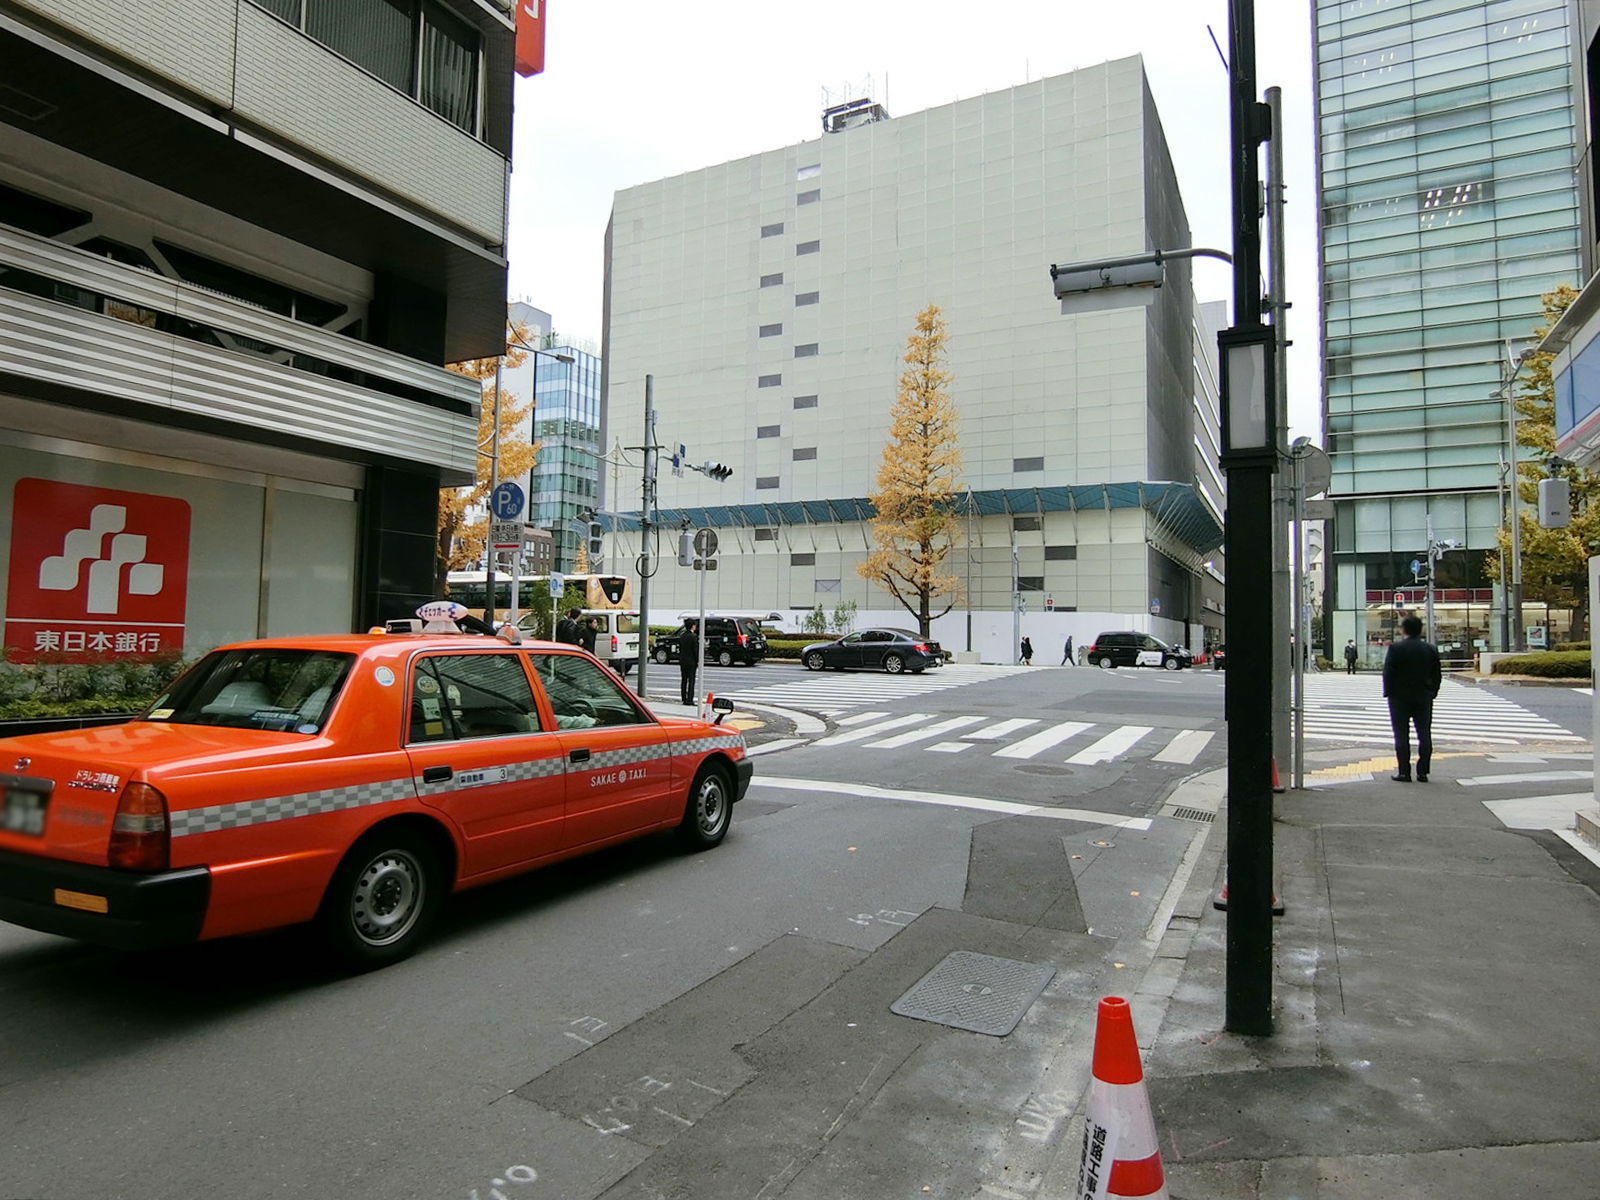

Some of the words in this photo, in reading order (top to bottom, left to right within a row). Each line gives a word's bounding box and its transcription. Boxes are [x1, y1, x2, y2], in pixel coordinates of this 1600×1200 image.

[498, 490, 511, 514] P
[506, 503, 517, 514] 60
[34, 630, 161, 653] 東日本銀行
[500, 769, 506, 779] 3
[590, 772, 617, 787] SAKAE
[629, 768, 647, 780] TAXI
